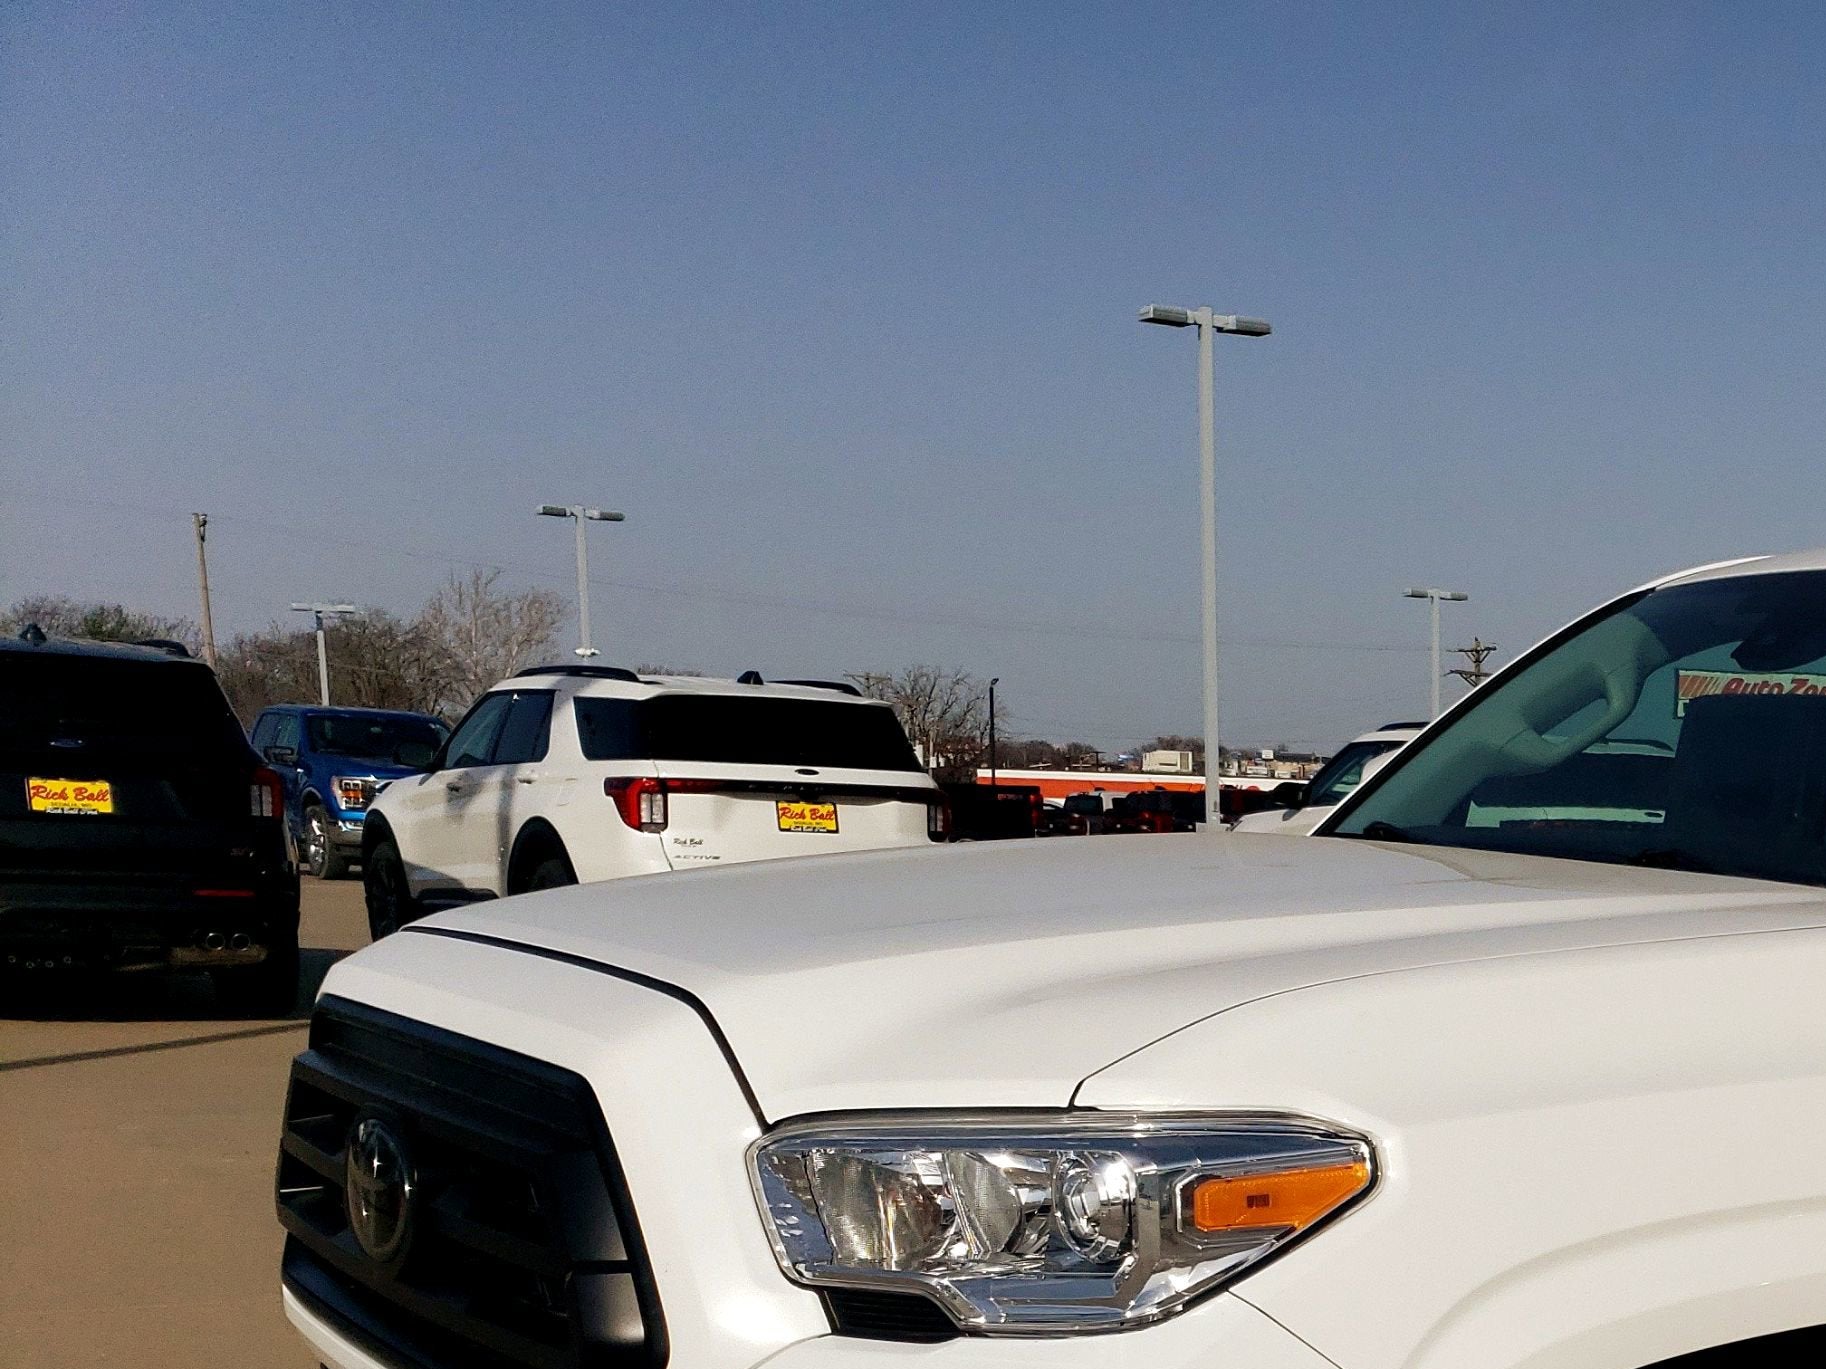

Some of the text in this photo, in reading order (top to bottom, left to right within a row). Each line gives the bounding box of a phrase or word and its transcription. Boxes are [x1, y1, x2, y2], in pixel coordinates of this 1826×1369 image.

[31, 785, 109, 802] Rick Ball
[779, 806, 836, 821] Rick Ball
